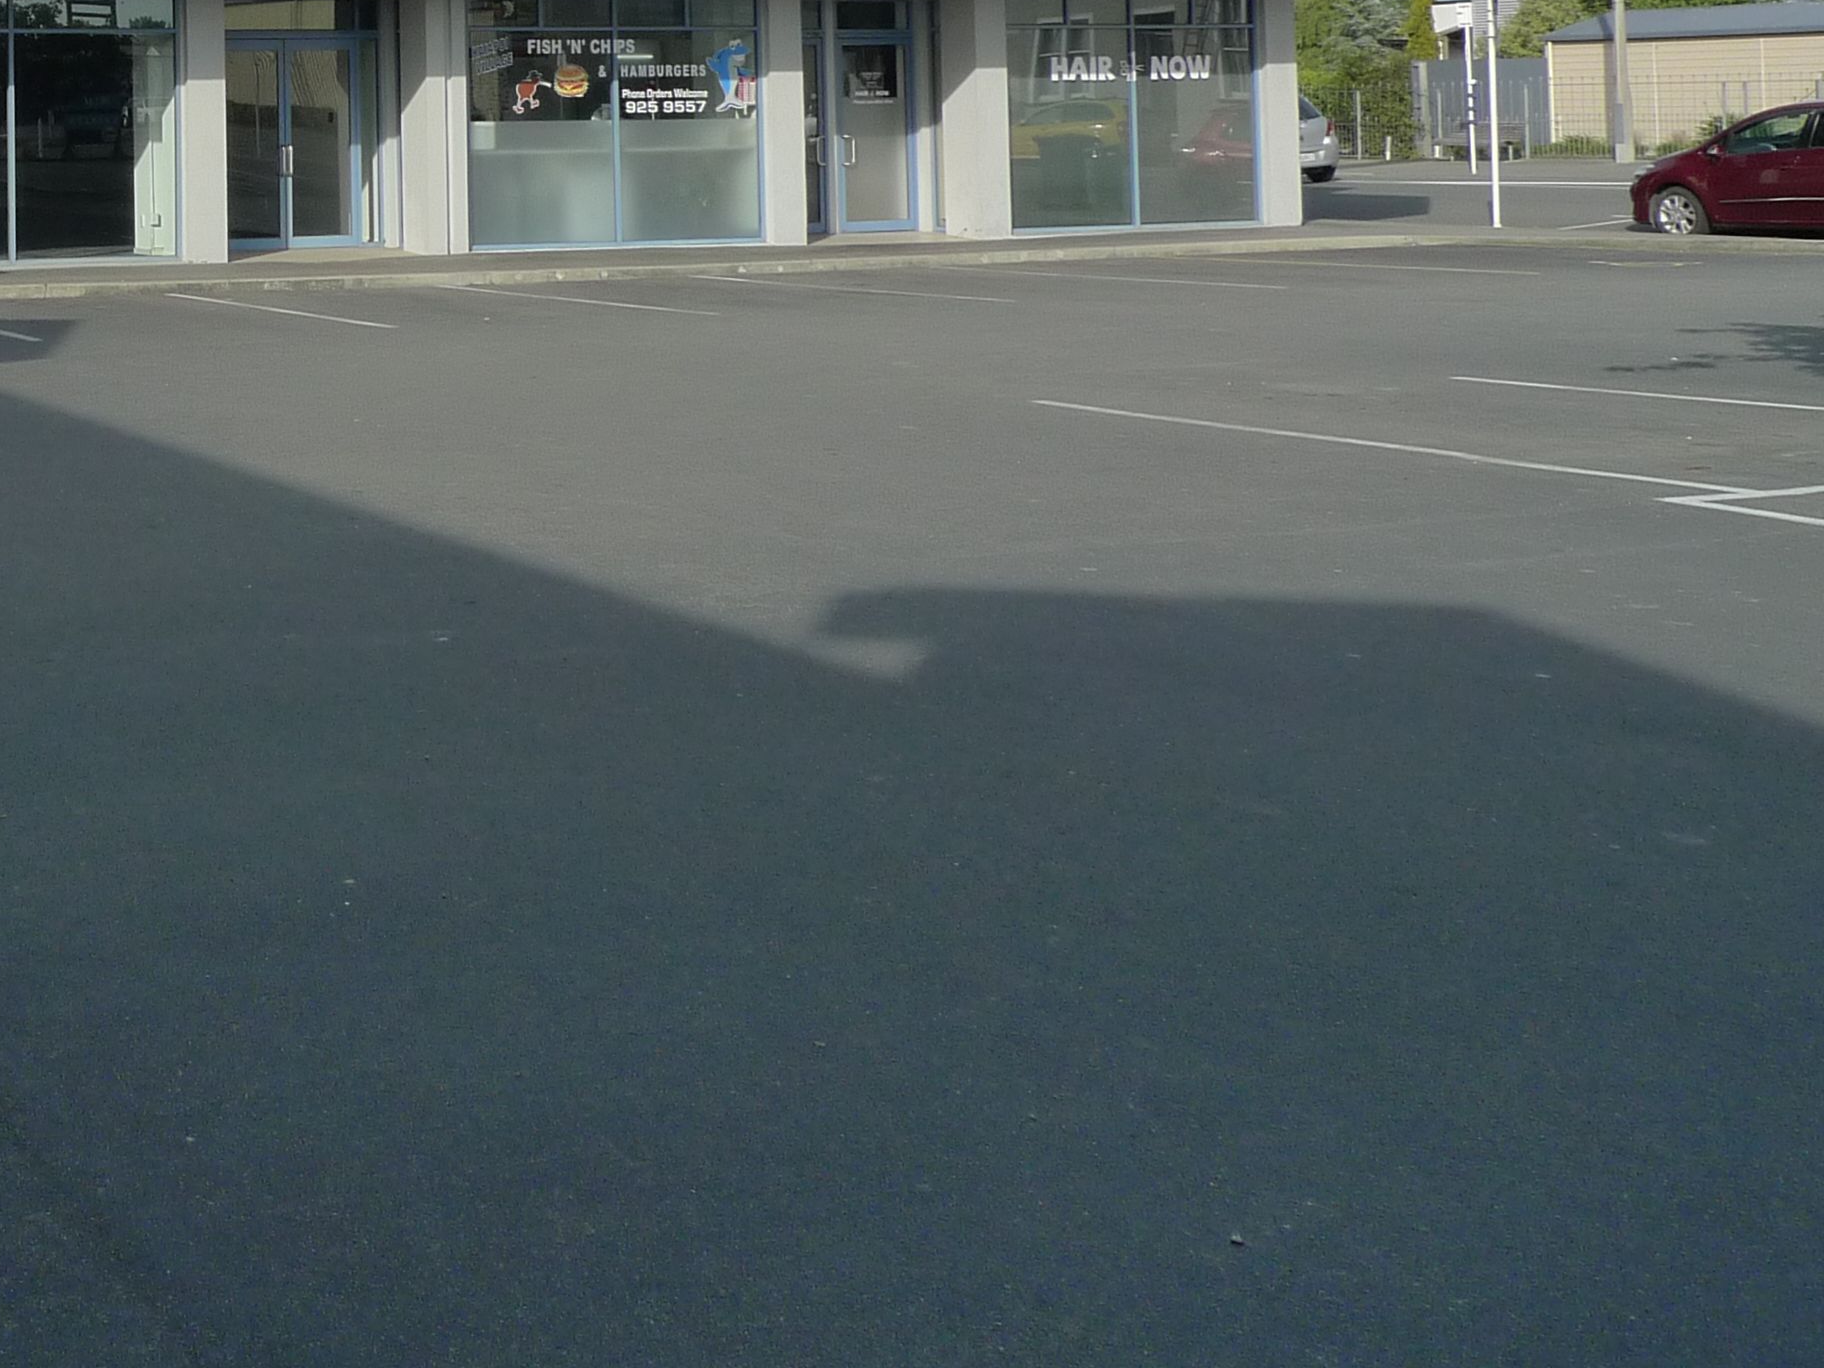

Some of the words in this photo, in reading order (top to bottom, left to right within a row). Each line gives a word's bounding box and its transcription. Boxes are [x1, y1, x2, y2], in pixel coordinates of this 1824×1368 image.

[527, 39, 562, 54] FISH
[566, 39, 586, 54] 'N'
[590, 39, 636, 54] CHIPS
[598, 65, 607, 78] &
[620, 65, 707, 78] HAMBURGERS
[1050, 55, 1116, 82] HAIR
[1150, 54, 1211, 81] NOW
[622, 89, 645, 99] Phone
[646, 89, 672, 99] Orders
[674, 89, 709, 99] Welcome
[625, 101, 658, 114] 925
[663, 101, 707, 113] 9557
